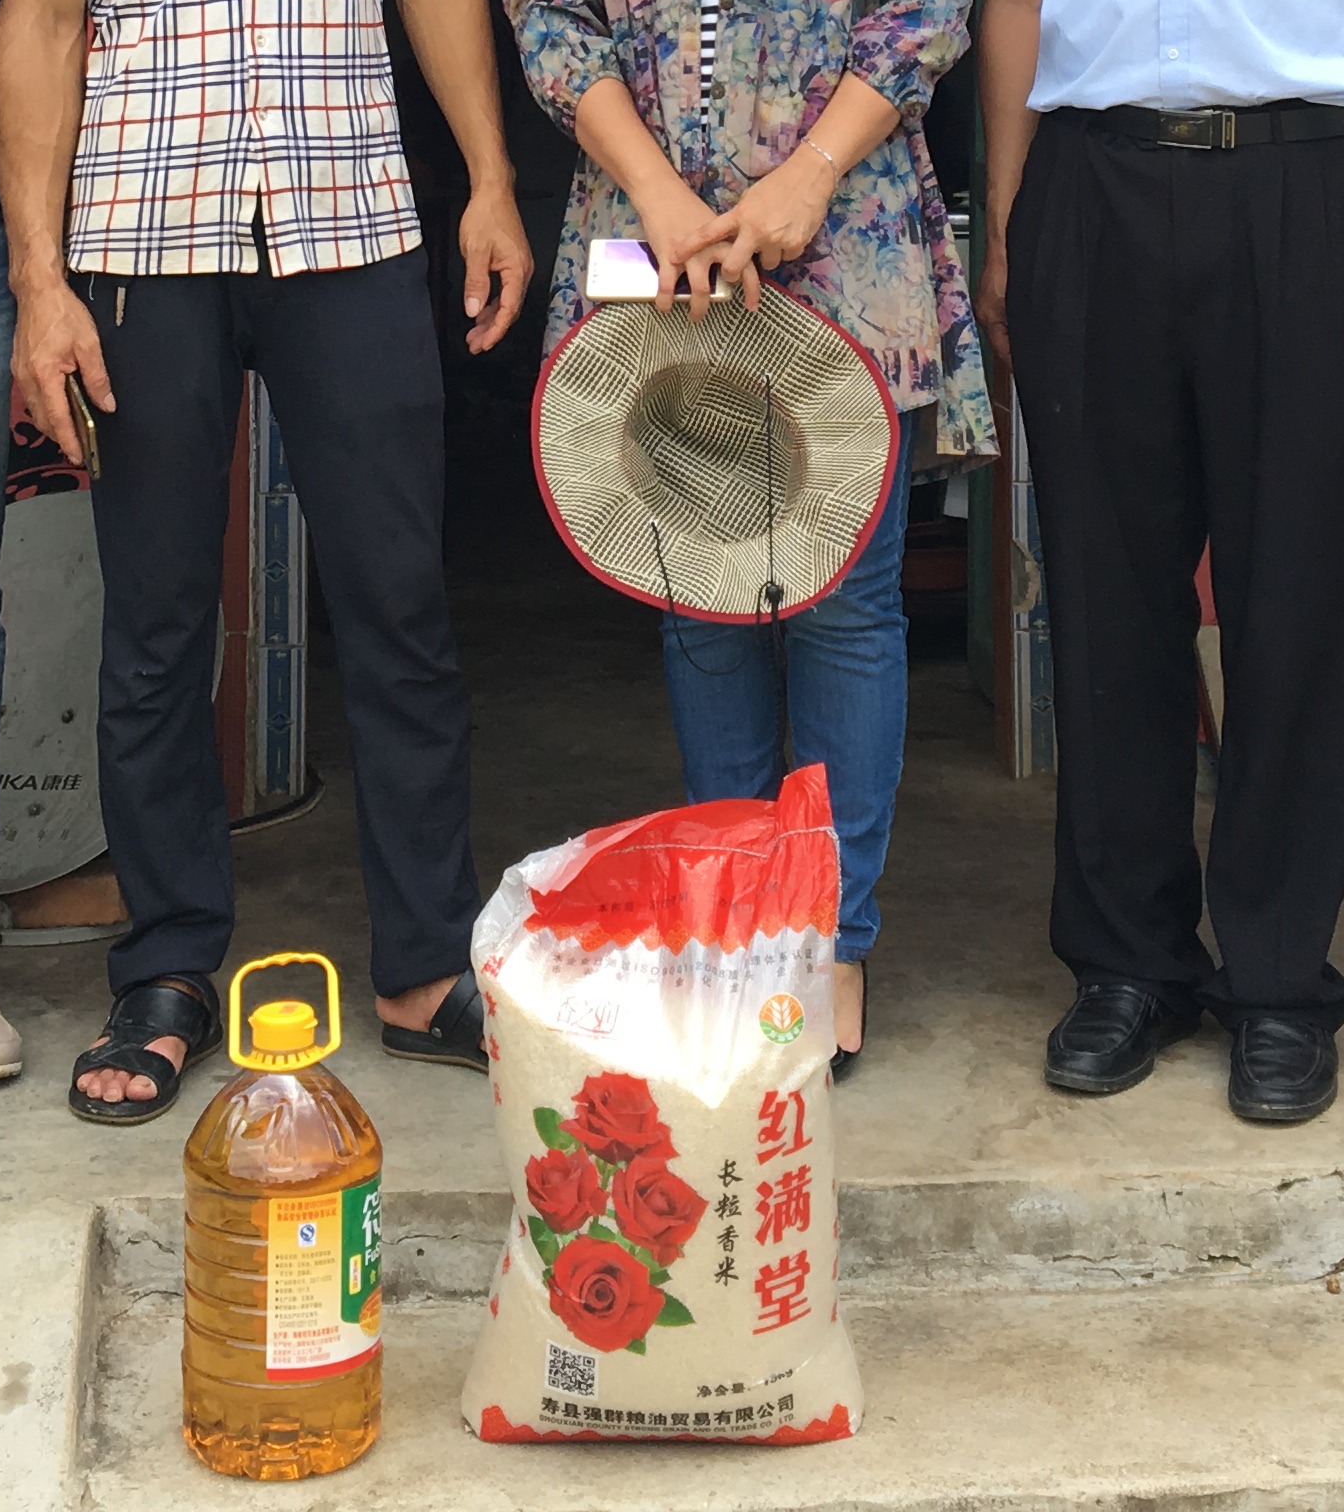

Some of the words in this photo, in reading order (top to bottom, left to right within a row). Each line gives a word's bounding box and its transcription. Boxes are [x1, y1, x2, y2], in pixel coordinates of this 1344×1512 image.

[714, 1159, 744, 1287] 长粒香米
[752, 1089, 813, 1335] 红满堂
[541, 1393, 794, 1426] 寿县强群粮油贸易有限公司
